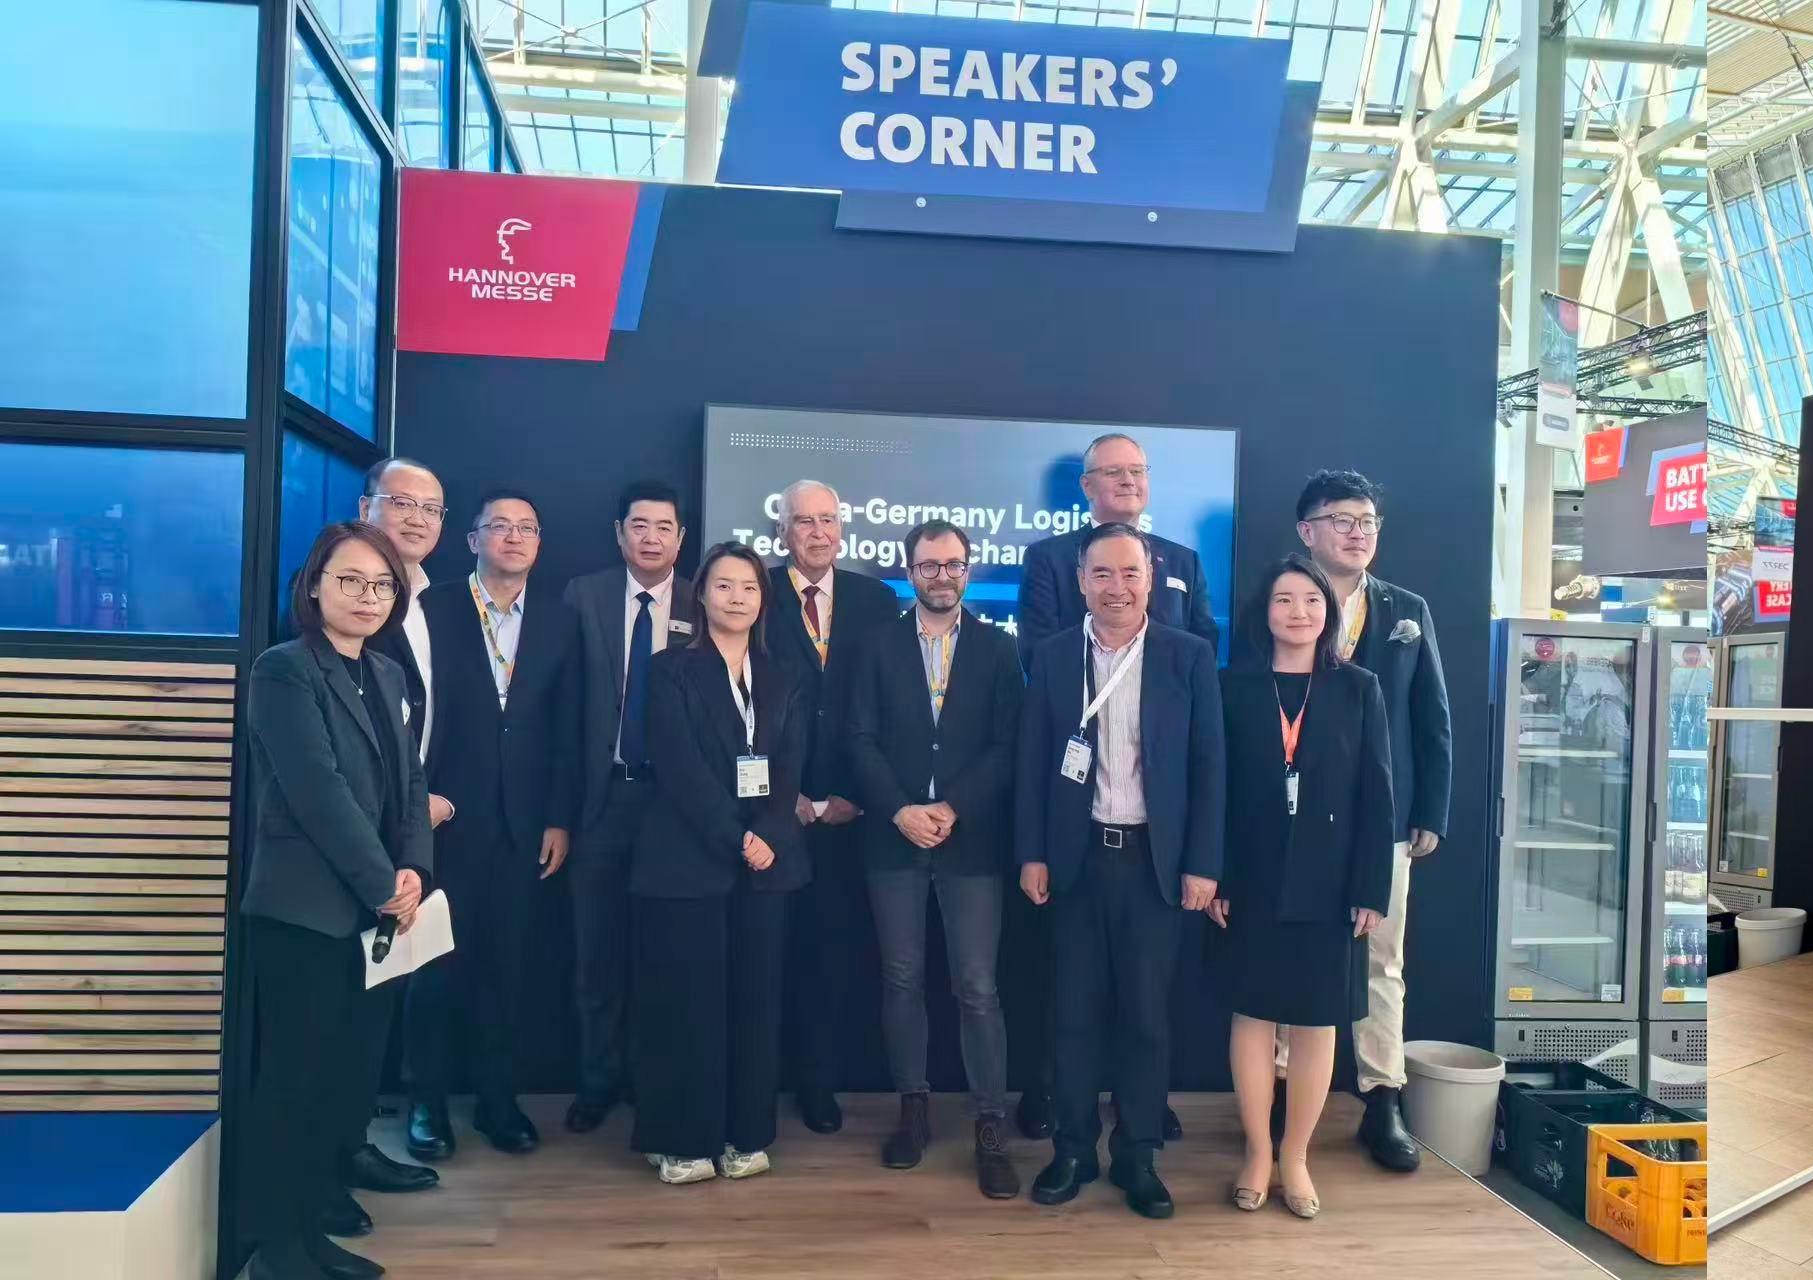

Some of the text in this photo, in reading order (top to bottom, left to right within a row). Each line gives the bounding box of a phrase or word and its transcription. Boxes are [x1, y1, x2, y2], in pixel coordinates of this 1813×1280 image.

[839, 111, 1099, 175] CORNER
[448, 267, 576, 288] HANNOVER
[470, 284, 554, 302] MESSE
[1665, 491, 1697, 512] USE
